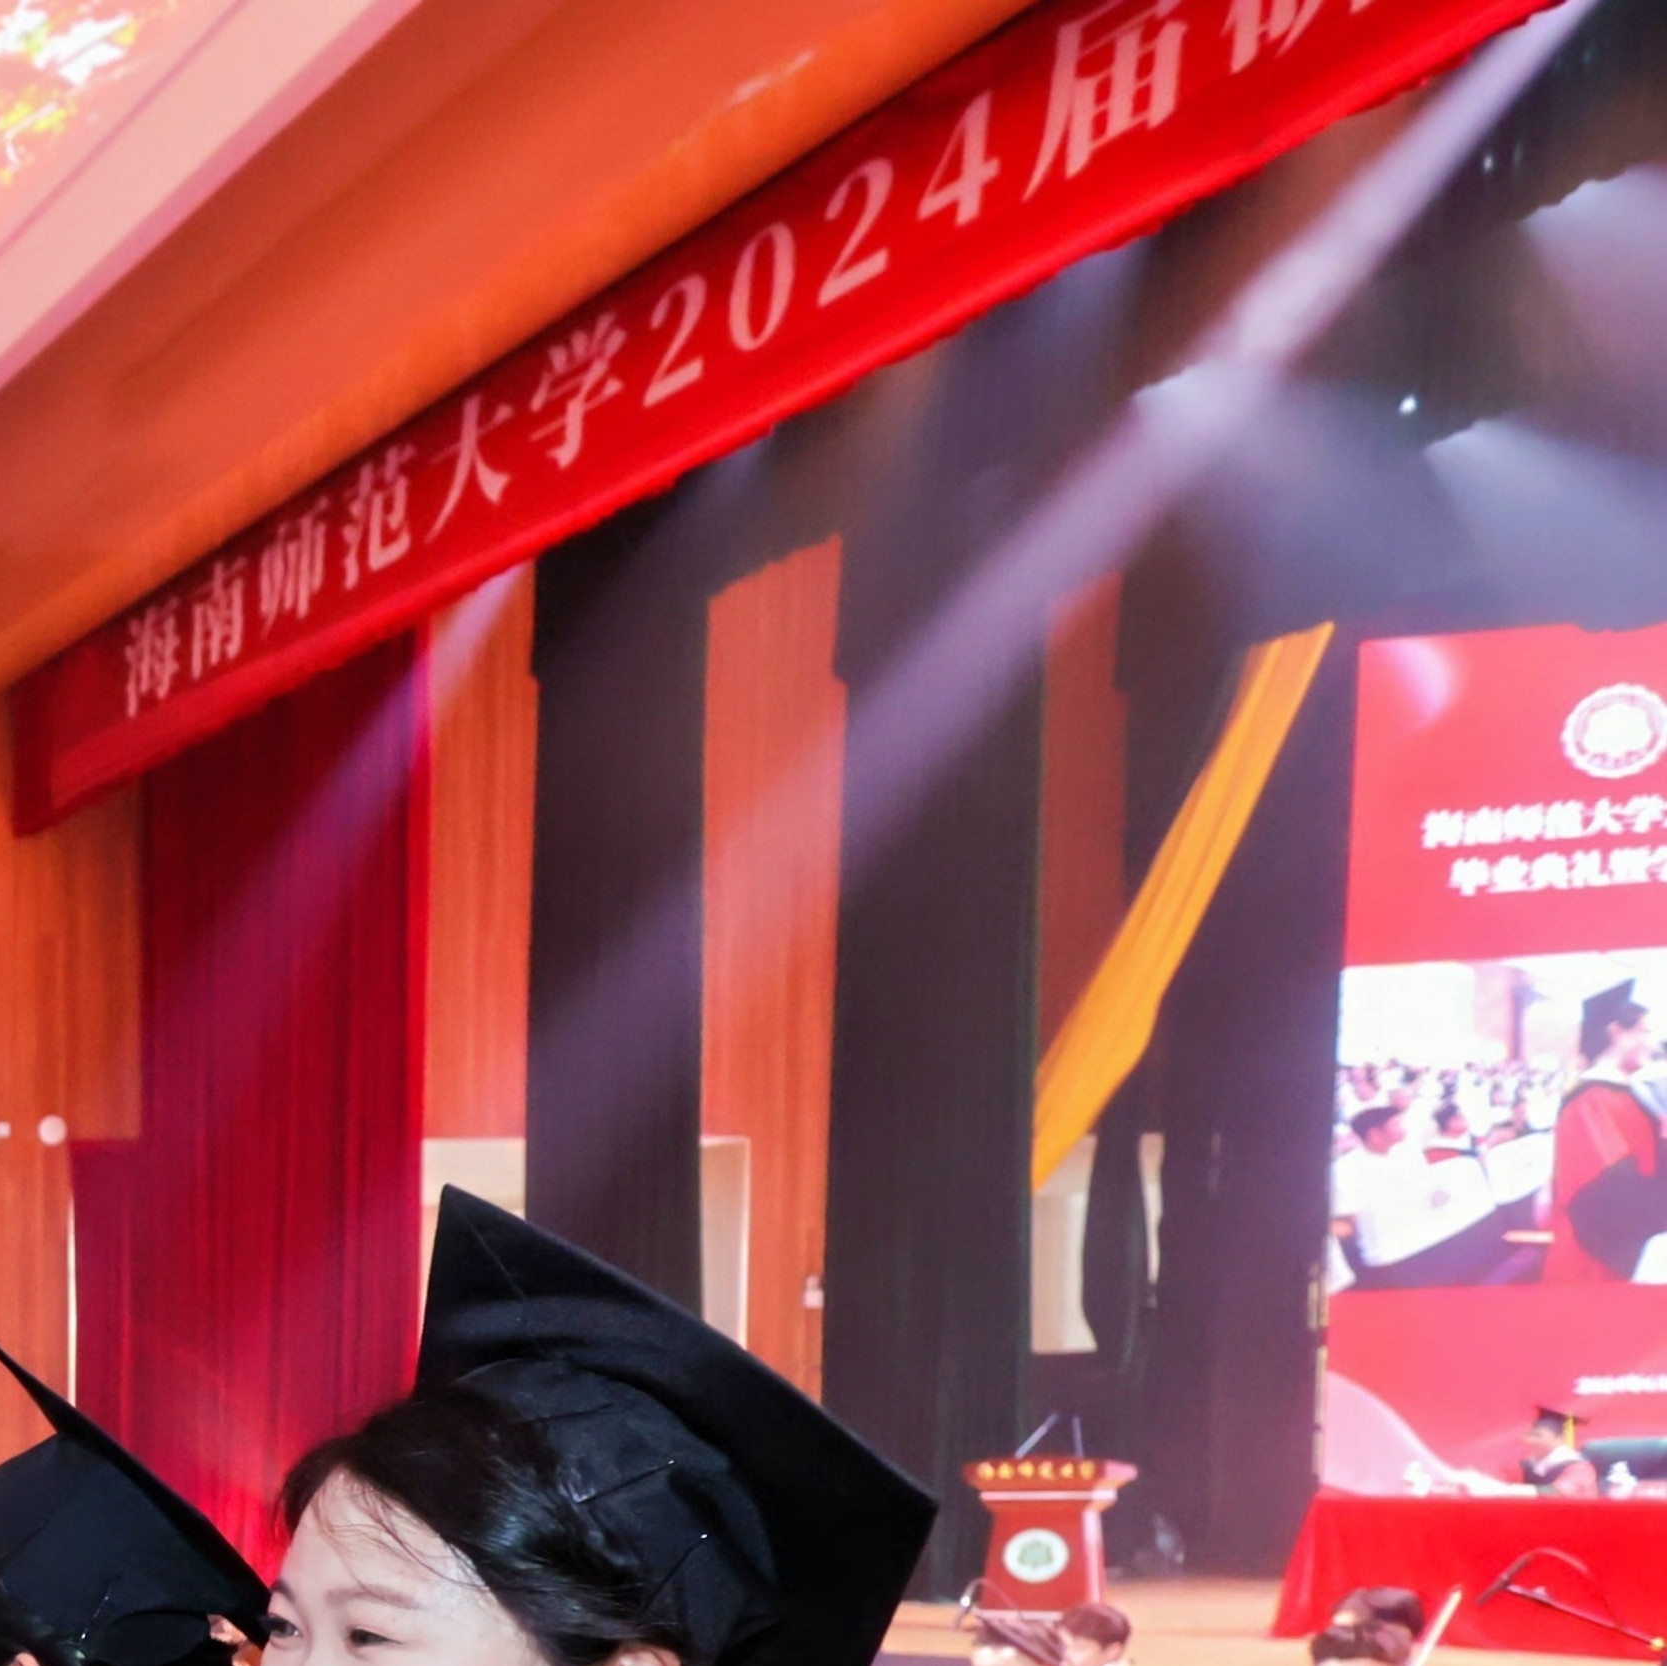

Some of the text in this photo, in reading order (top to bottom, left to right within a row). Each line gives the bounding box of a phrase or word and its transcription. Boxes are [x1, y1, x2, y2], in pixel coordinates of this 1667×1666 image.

[124, 0, 1369, 718] 海南师范大学2024届
[1422, 794, 1667, 849] 海南师范大学
